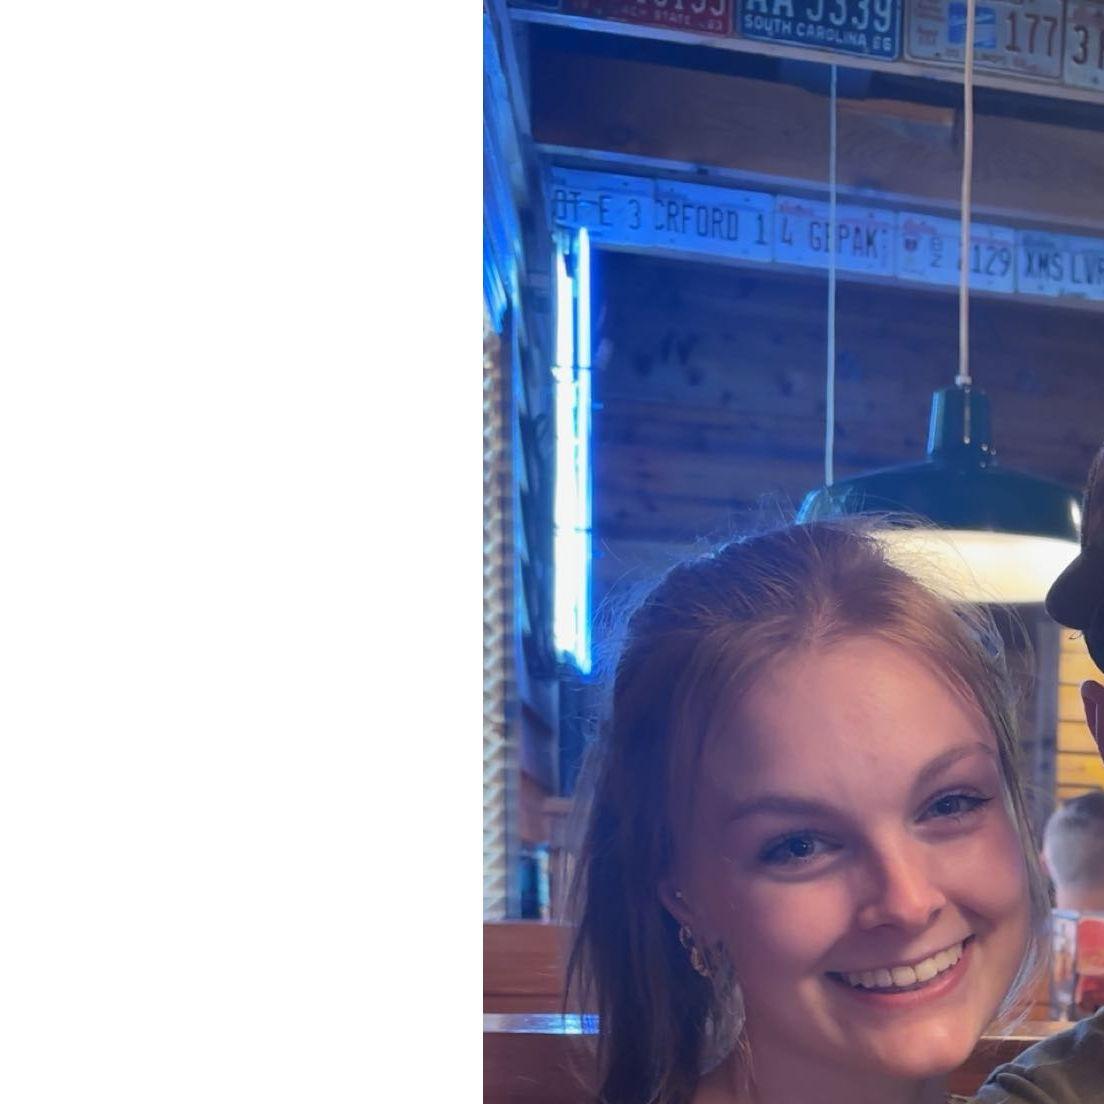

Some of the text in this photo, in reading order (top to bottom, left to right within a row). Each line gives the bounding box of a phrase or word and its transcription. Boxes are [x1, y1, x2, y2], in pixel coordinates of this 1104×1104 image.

[744, 14, 792, 35] SOUTH
[796, 22, 867, 48] CAROLINA
[1005, 9, 1058, 57] 177
[1072, 24, 1089, 65] 3
[755, 213, 768, 245] 1
[780, 216, 793, 246] 4
